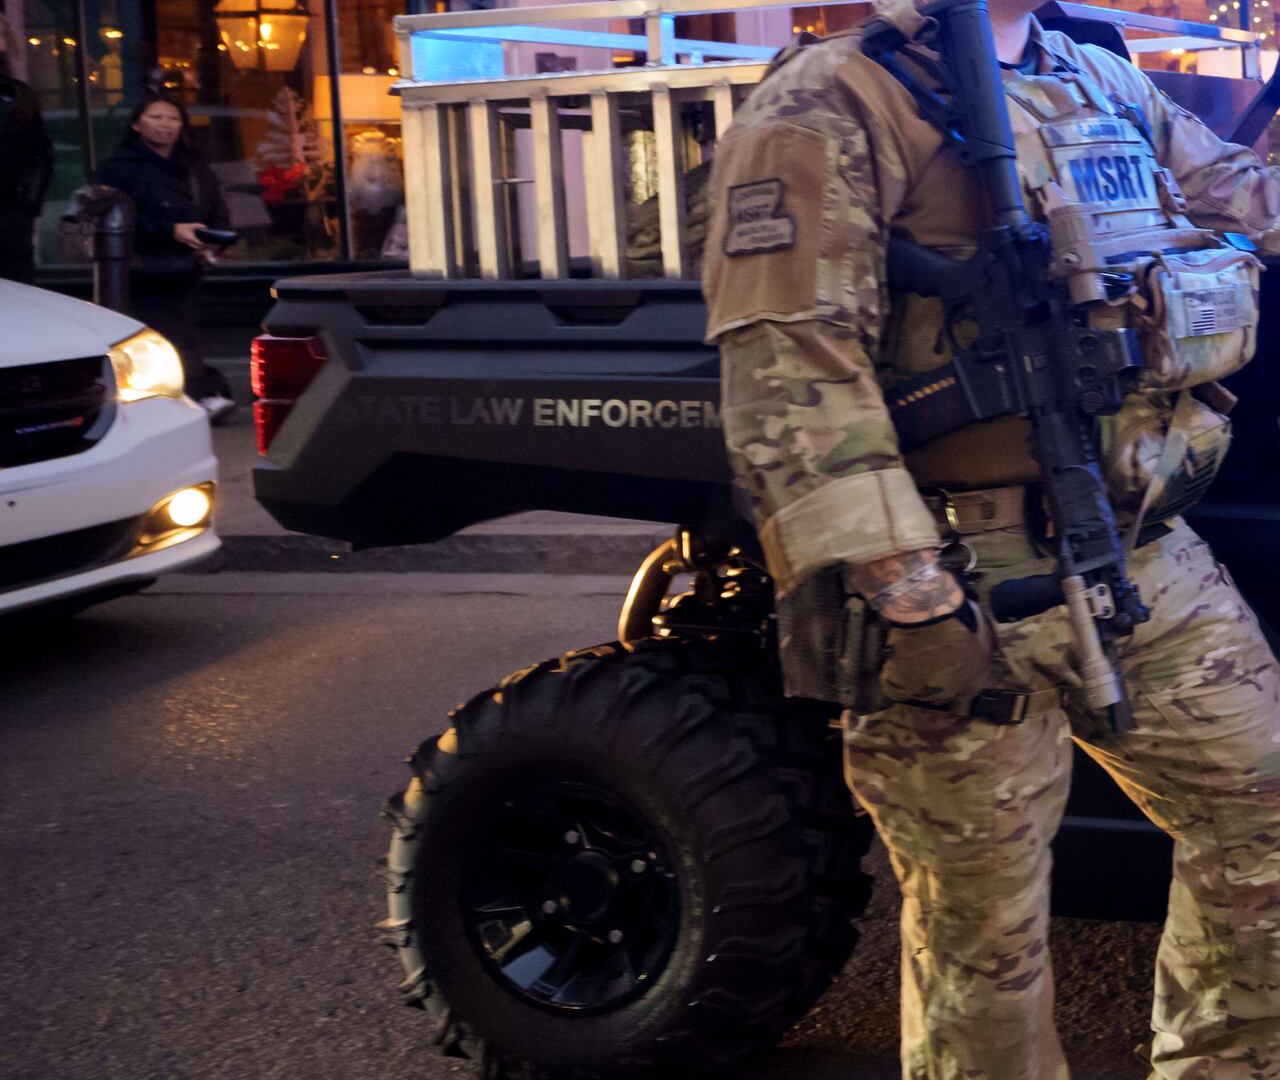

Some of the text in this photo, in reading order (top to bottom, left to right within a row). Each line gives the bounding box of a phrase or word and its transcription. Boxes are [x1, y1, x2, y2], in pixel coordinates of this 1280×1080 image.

[1068, 155, 1149, 203] MSRT
[340, 396, 441, 424] STATE
[450, 397, 525, 426] LAW
